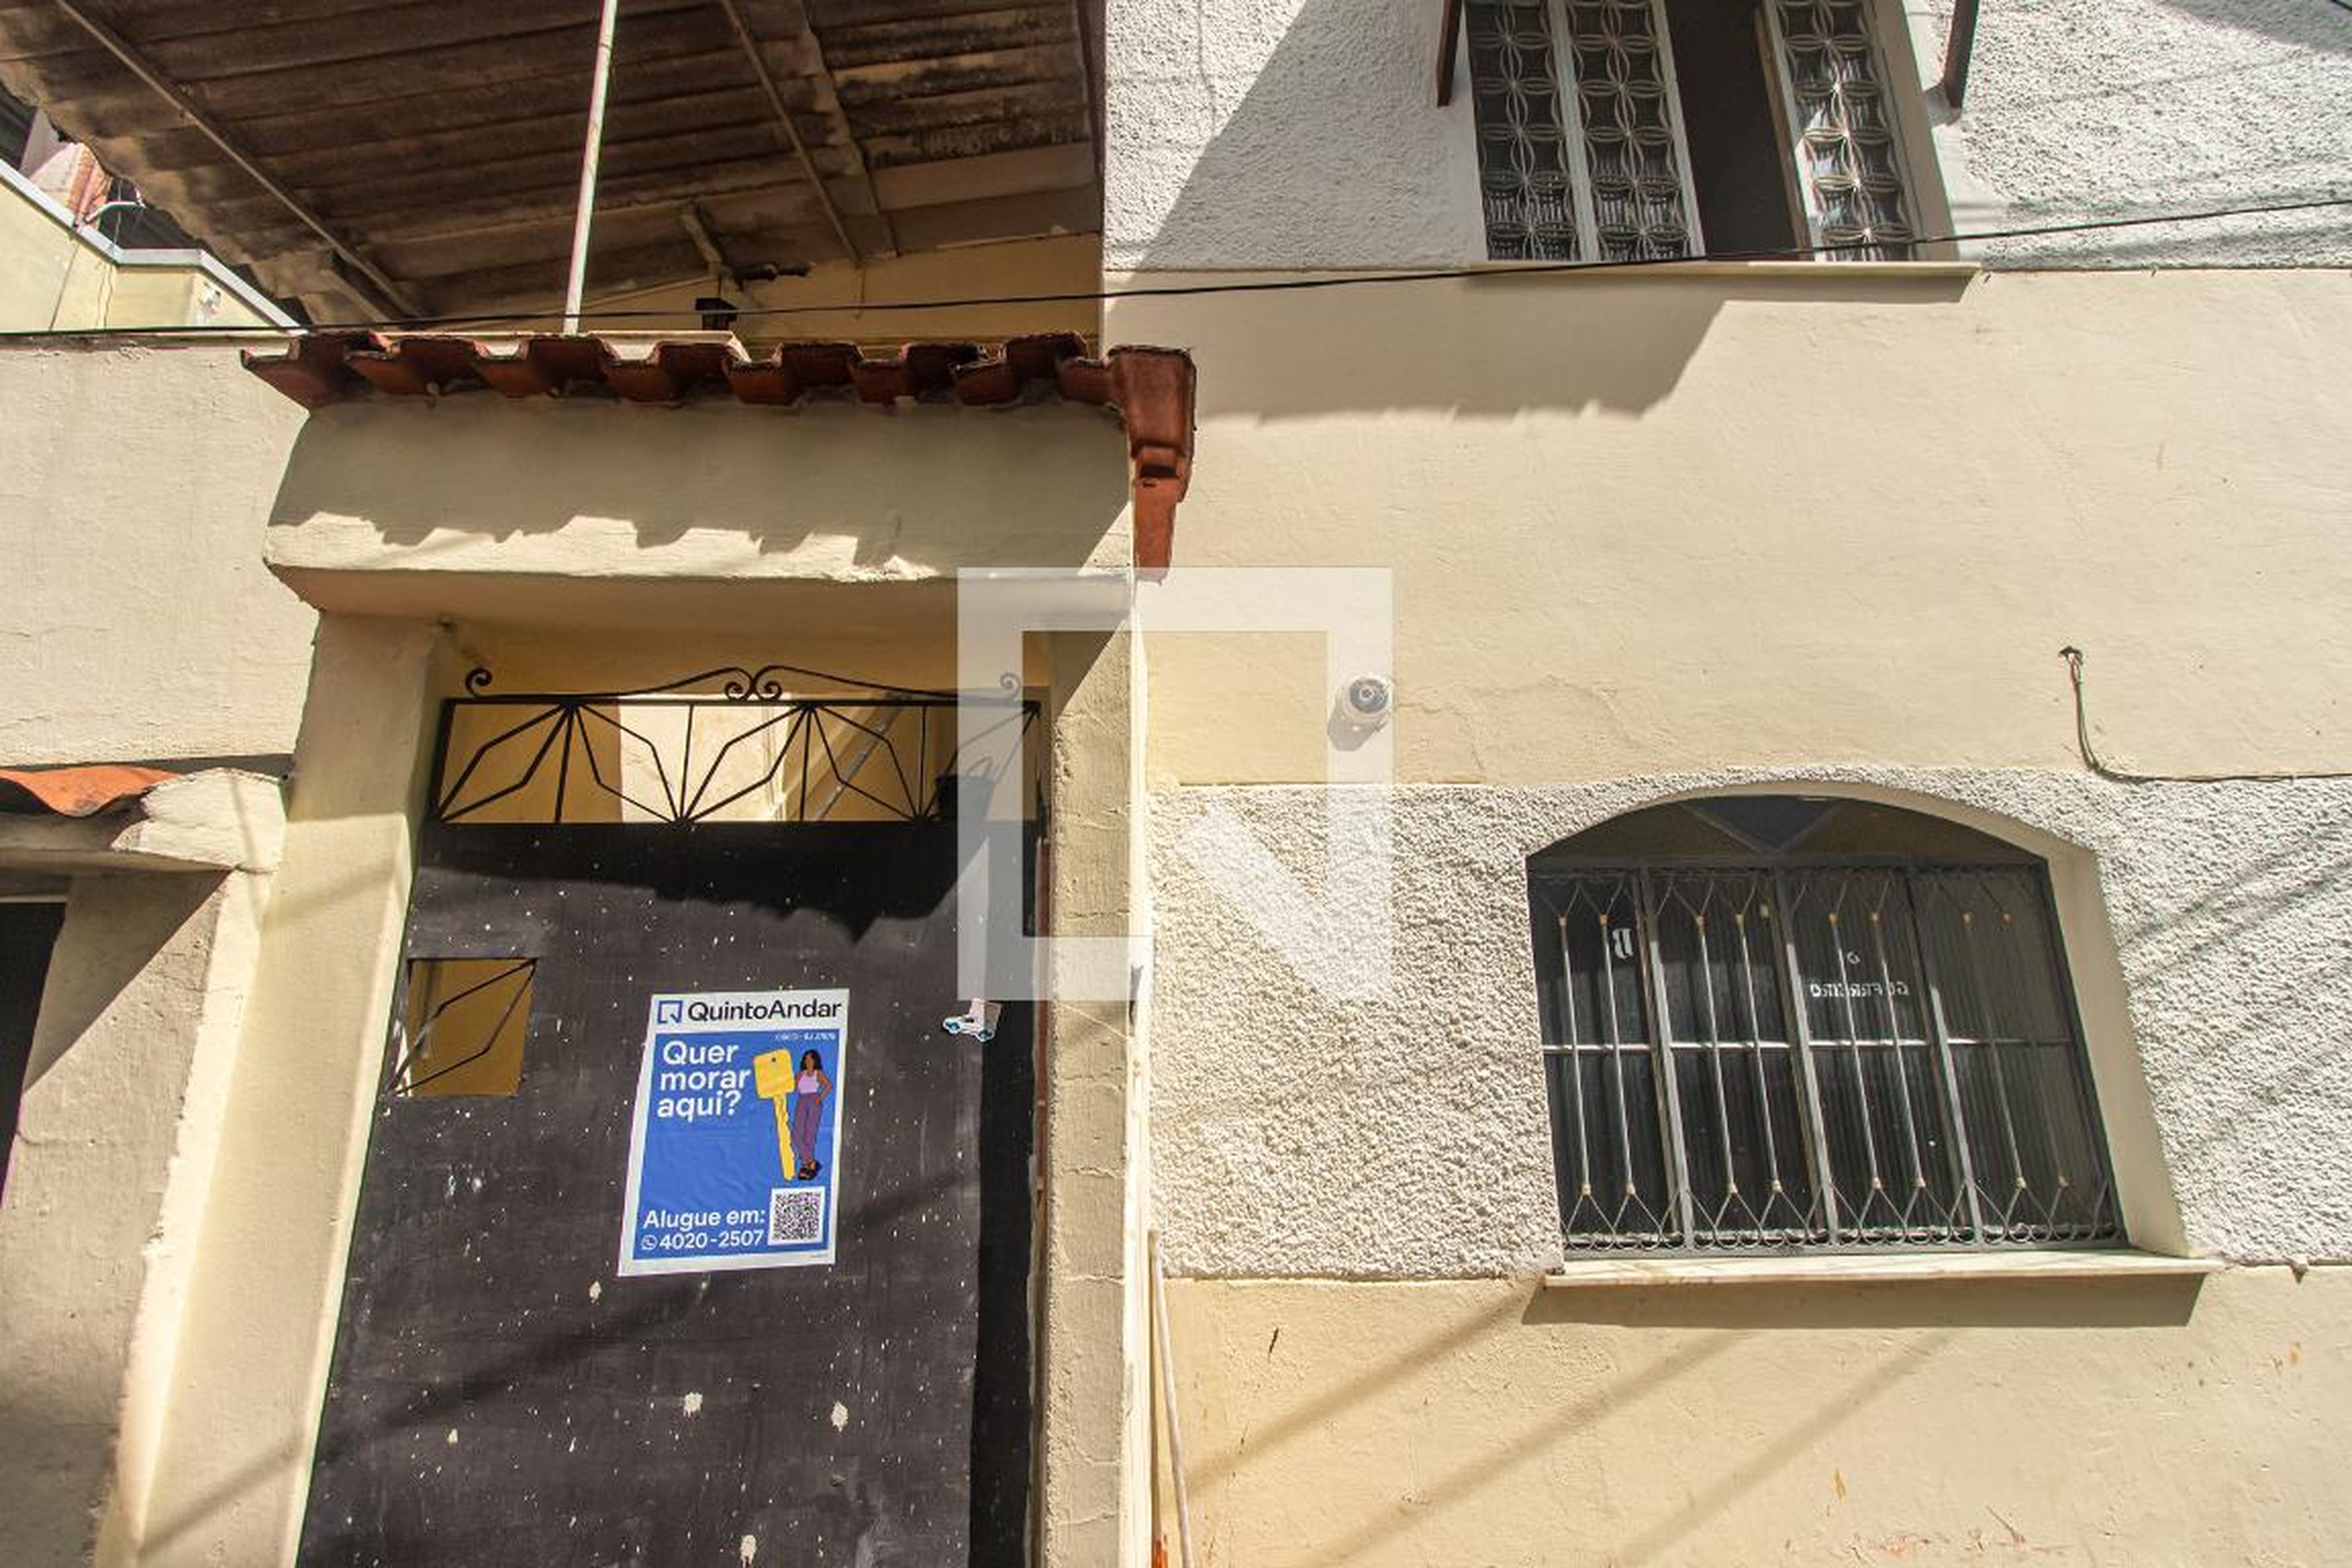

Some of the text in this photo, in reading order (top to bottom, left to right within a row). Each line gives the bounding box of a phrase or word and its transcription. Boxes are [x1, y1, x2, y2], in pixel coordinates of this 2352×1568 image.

[687, 998, 842, 1022] QuintoAndar
[663, 1040, 739, 1065] Quer
[660, 1069, 752, 1091] morar
[657, 1090, 742, 1123] aqui?
[643, 1209, 766, 1232] Alugue em:
